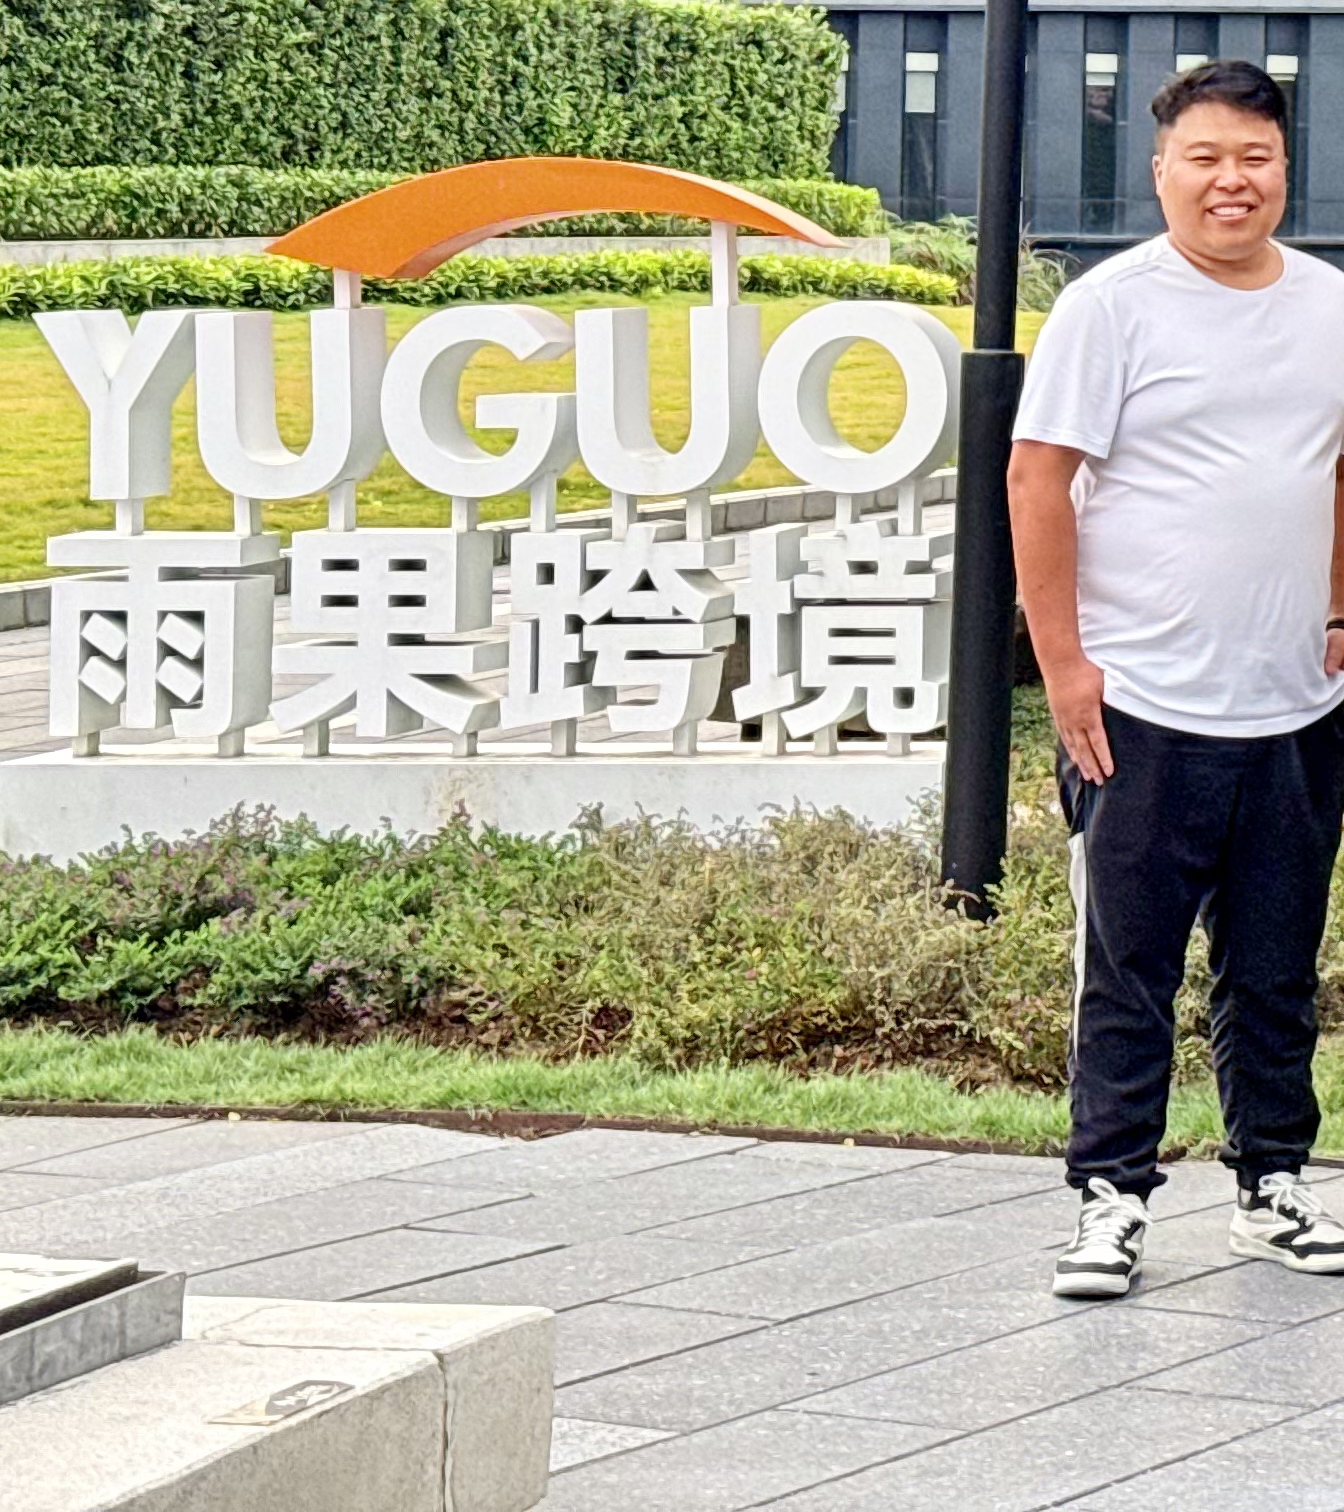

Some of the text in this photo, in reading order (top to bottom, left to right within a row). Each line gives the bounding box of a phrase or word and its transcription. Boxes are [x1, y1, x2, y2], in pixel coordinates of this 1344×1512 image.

[33, 299, 961, 500] YUGUO
[45, 518, 953, 737] 雨果跨境
